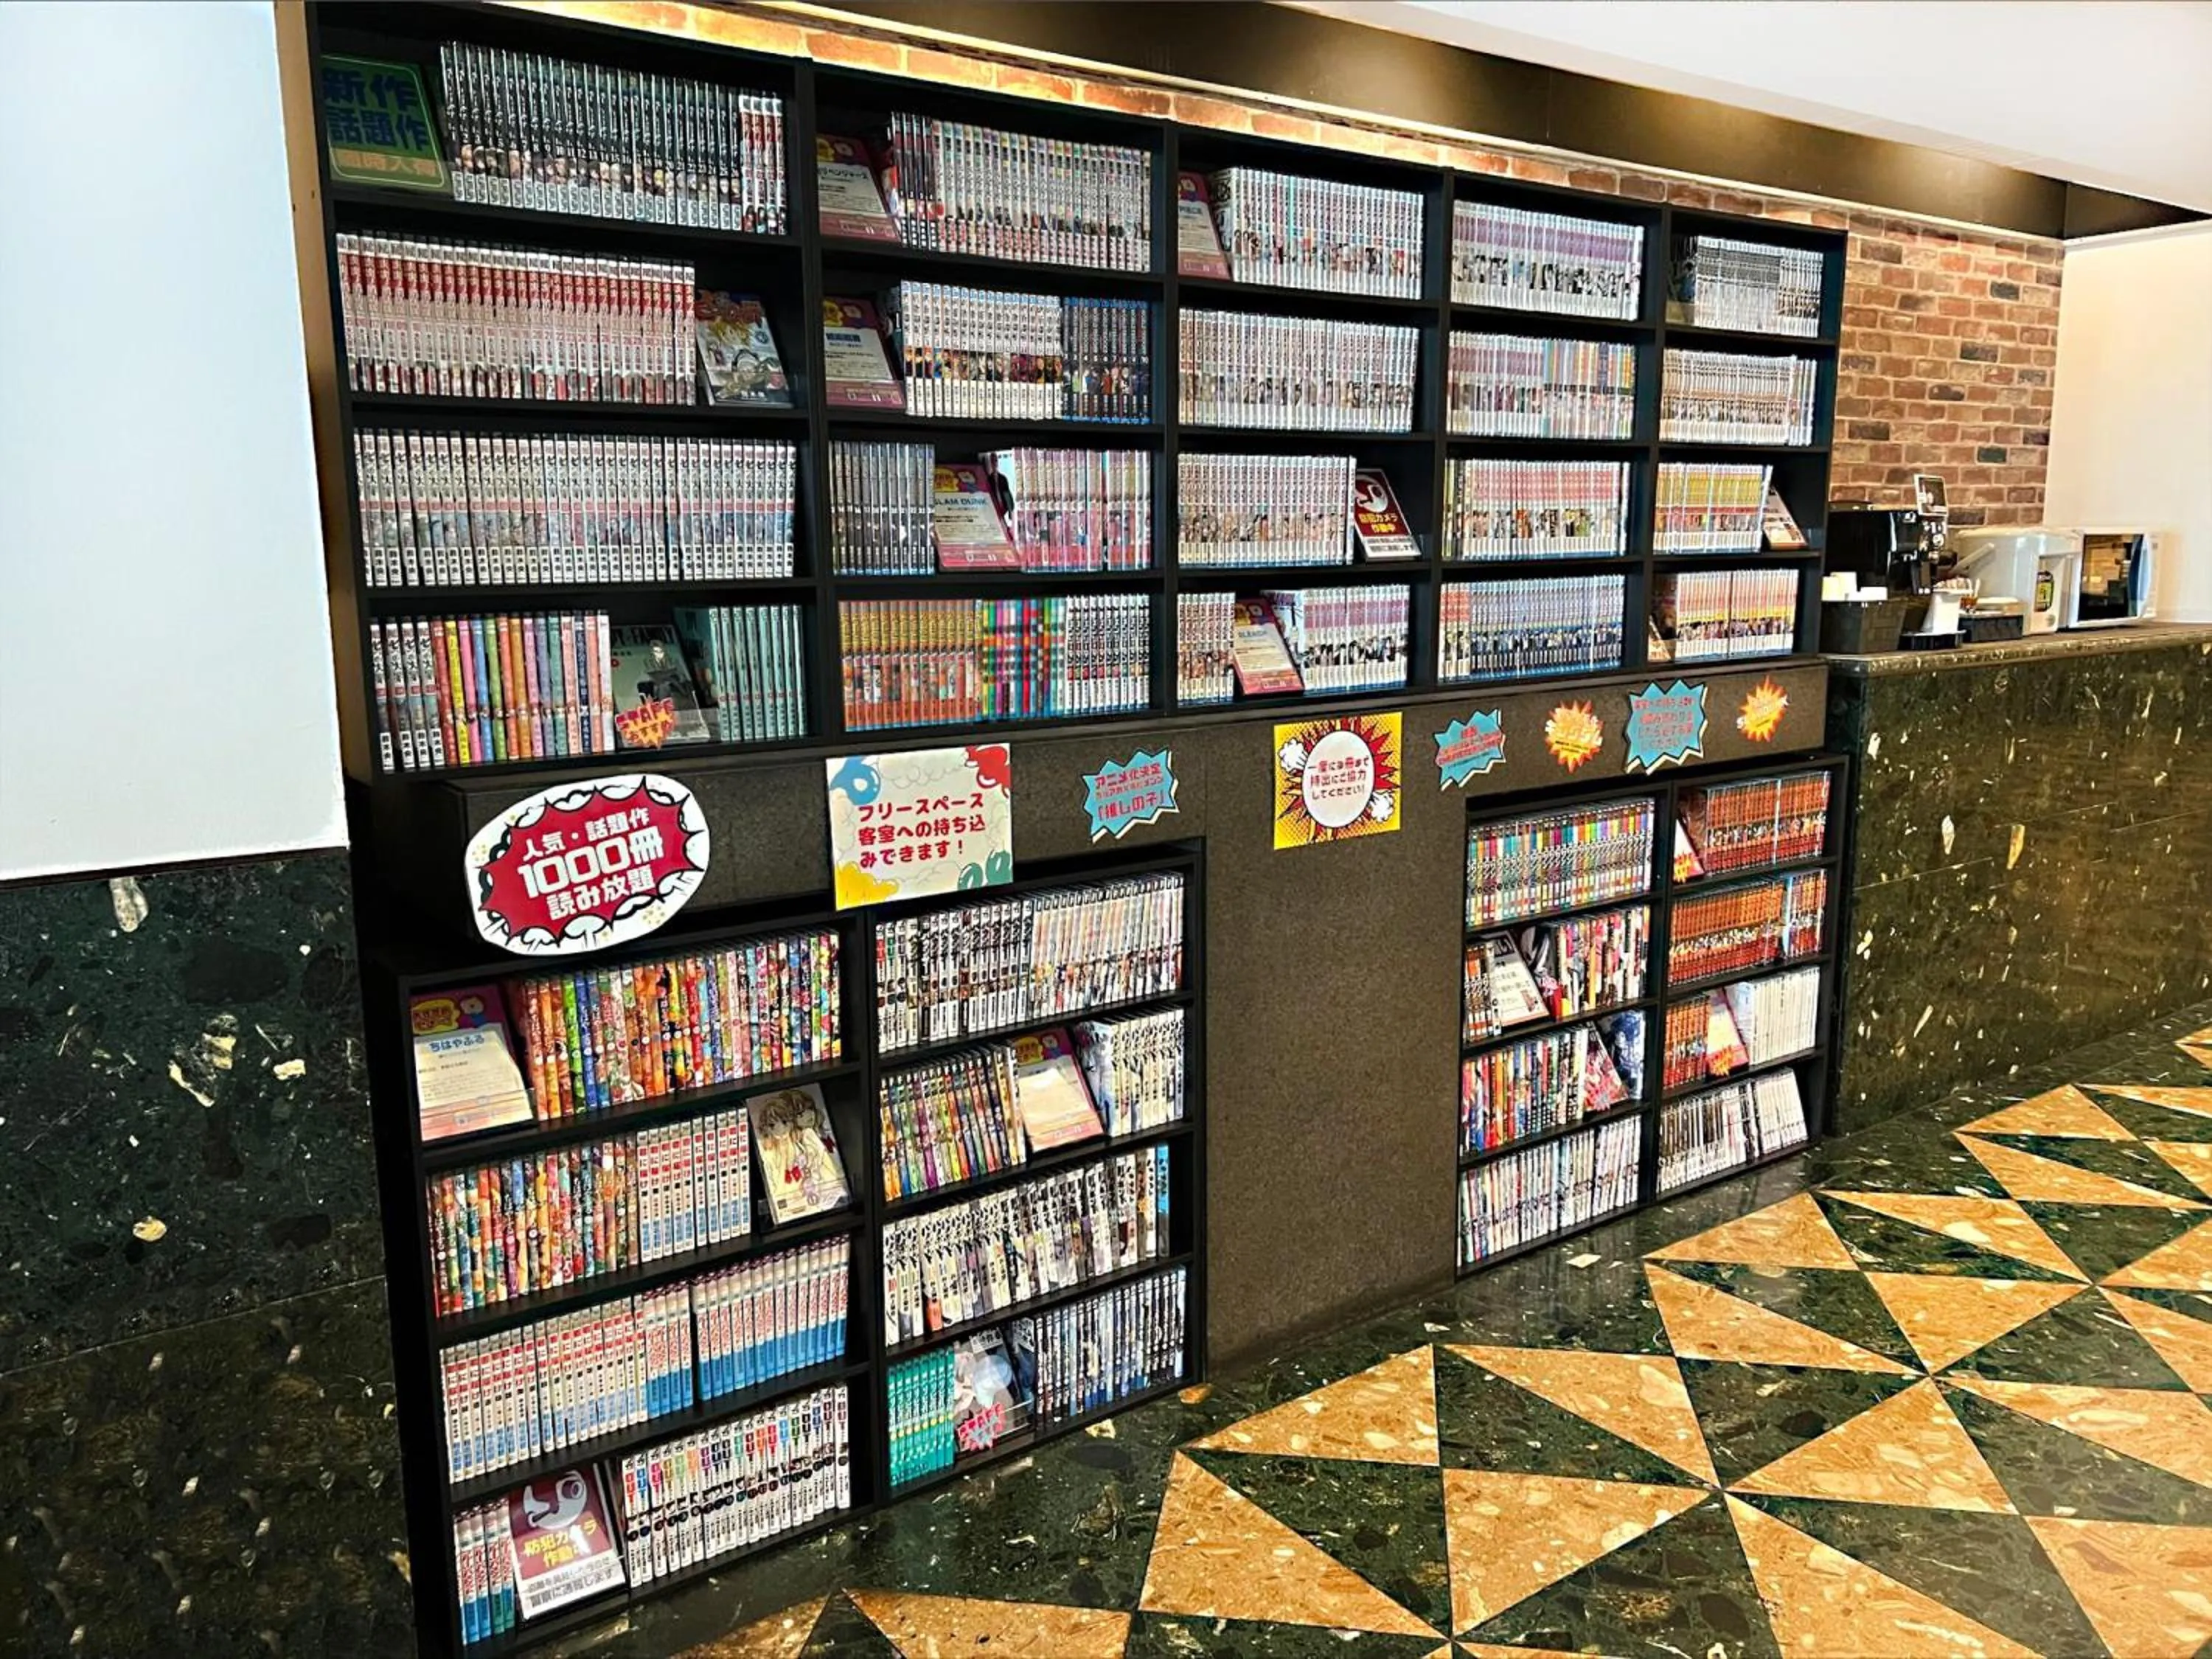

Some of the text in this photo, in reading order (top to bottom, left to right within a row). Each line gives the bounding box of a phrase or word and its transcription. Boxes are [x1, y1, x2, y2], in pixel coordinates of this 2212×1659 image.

[858, 793, 984, 822] フリースペース
[523, 807, 650, 861] 人気・話題作
[858, 814, 986, 846] 客室への持ち込
[518, 825, 664, 899] 1000冊
[860, 840, 964, 869] みできます！
[546, 864, 655, 920] 読み放題
[429, 1033, 484, 1052] ちはやふる
[802, 1413, 810, 1442] OUT
[812, 1406, 821, 1435] OUT
[824, 1402, 832, 1430] OUT
[838, 1402, 847, 1430] OUT
[768, 1425, 777, 1455] OUT
[779, 1420, 789, 1450] OUT
[791, 1417, 800, 1446] OUT
[701, 1447, 712, 1477] OUT
[712, 1442, 721, 1472] OUT
[722, 1439, 731, 1469] OUT
[745, 1433, 754, 1461] OUT
[625, 1473, 636, 1504] OUT
[636, 1468, 647, 1499] OUT
[651, 1463, 661, 1493] OUT
[663, 1458, 673, 1489] OUT
[524, 1519, 597, 1557] 防犯カラ
